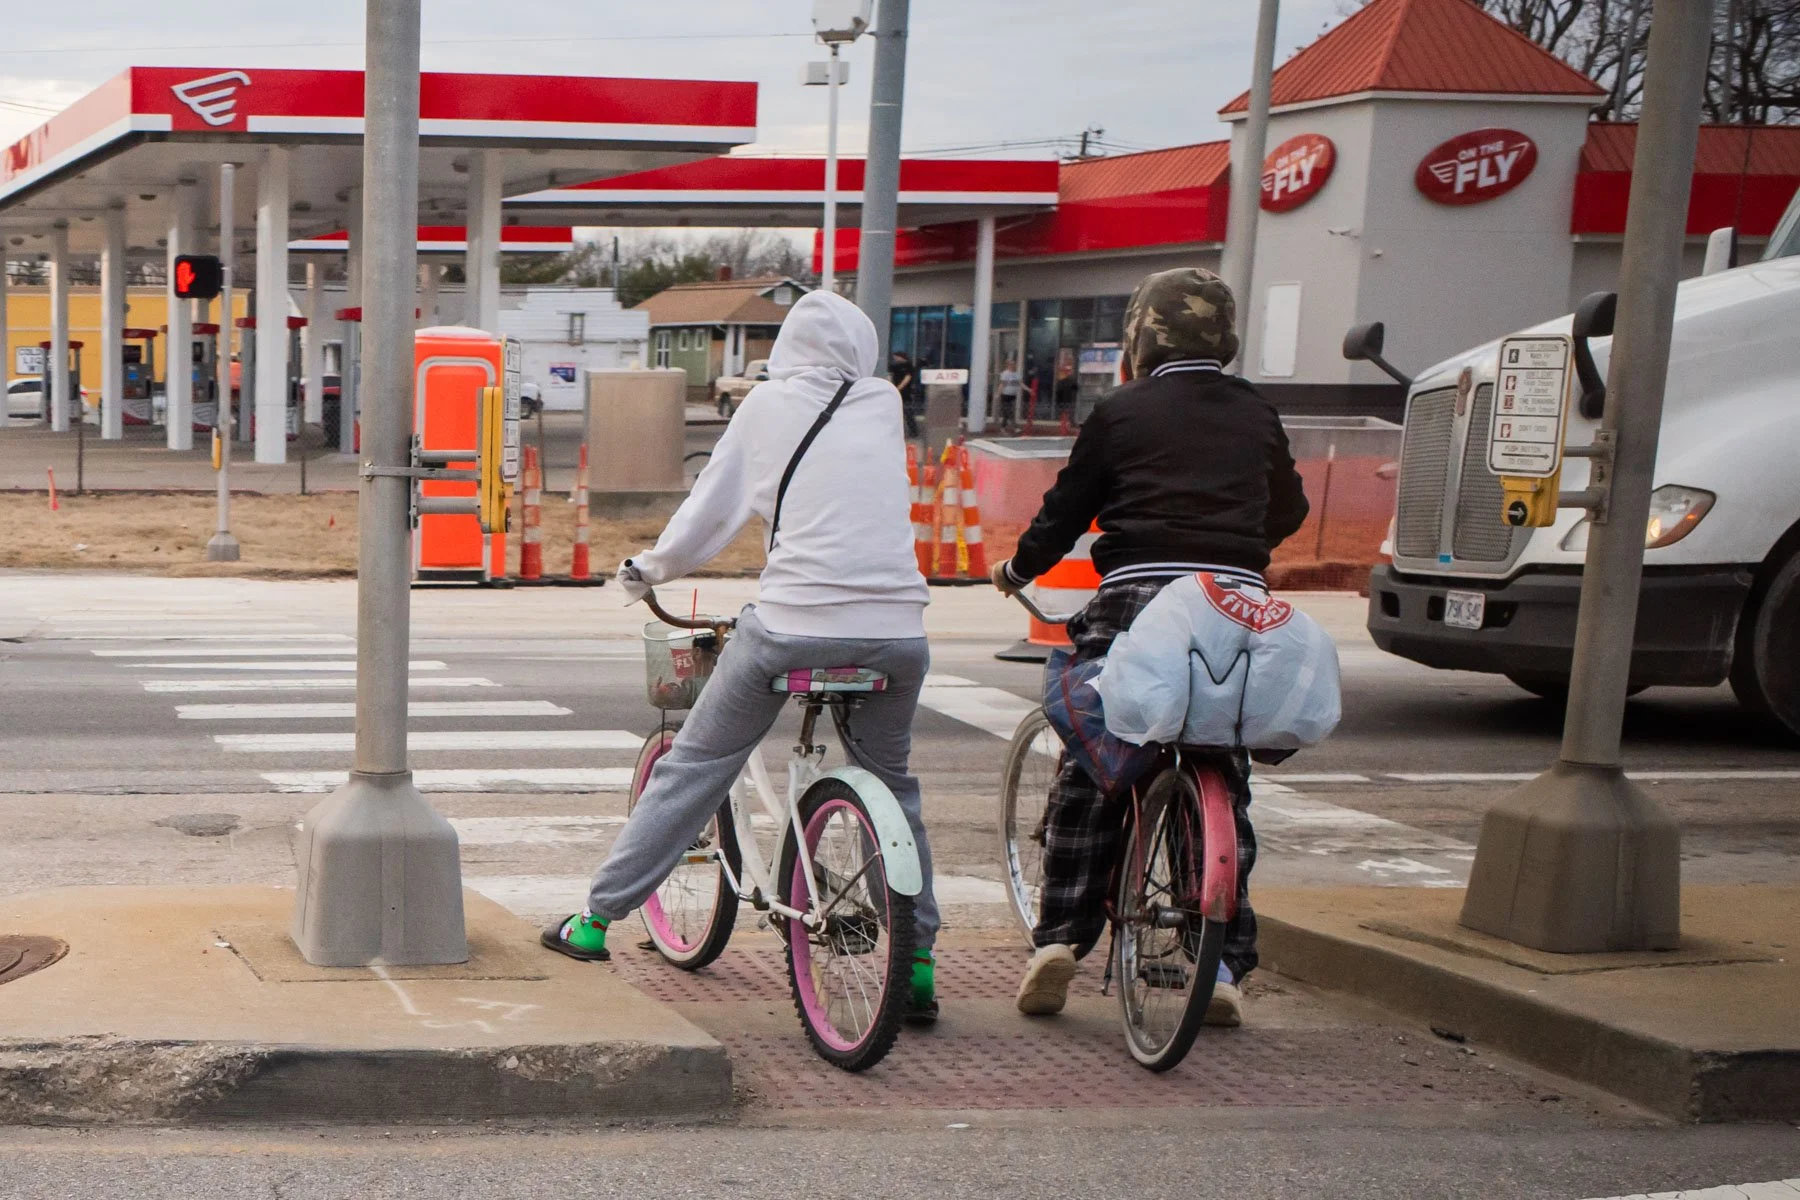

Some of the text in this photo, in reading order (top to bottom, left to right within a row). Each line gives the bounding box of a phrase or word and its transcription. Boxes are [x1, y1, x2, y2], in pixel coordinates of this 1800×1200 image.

[1272, 153, 1317, 201] FLY
[1454, 150, 1519, 194] FLY
[935, 372, 960, 381] AIR
